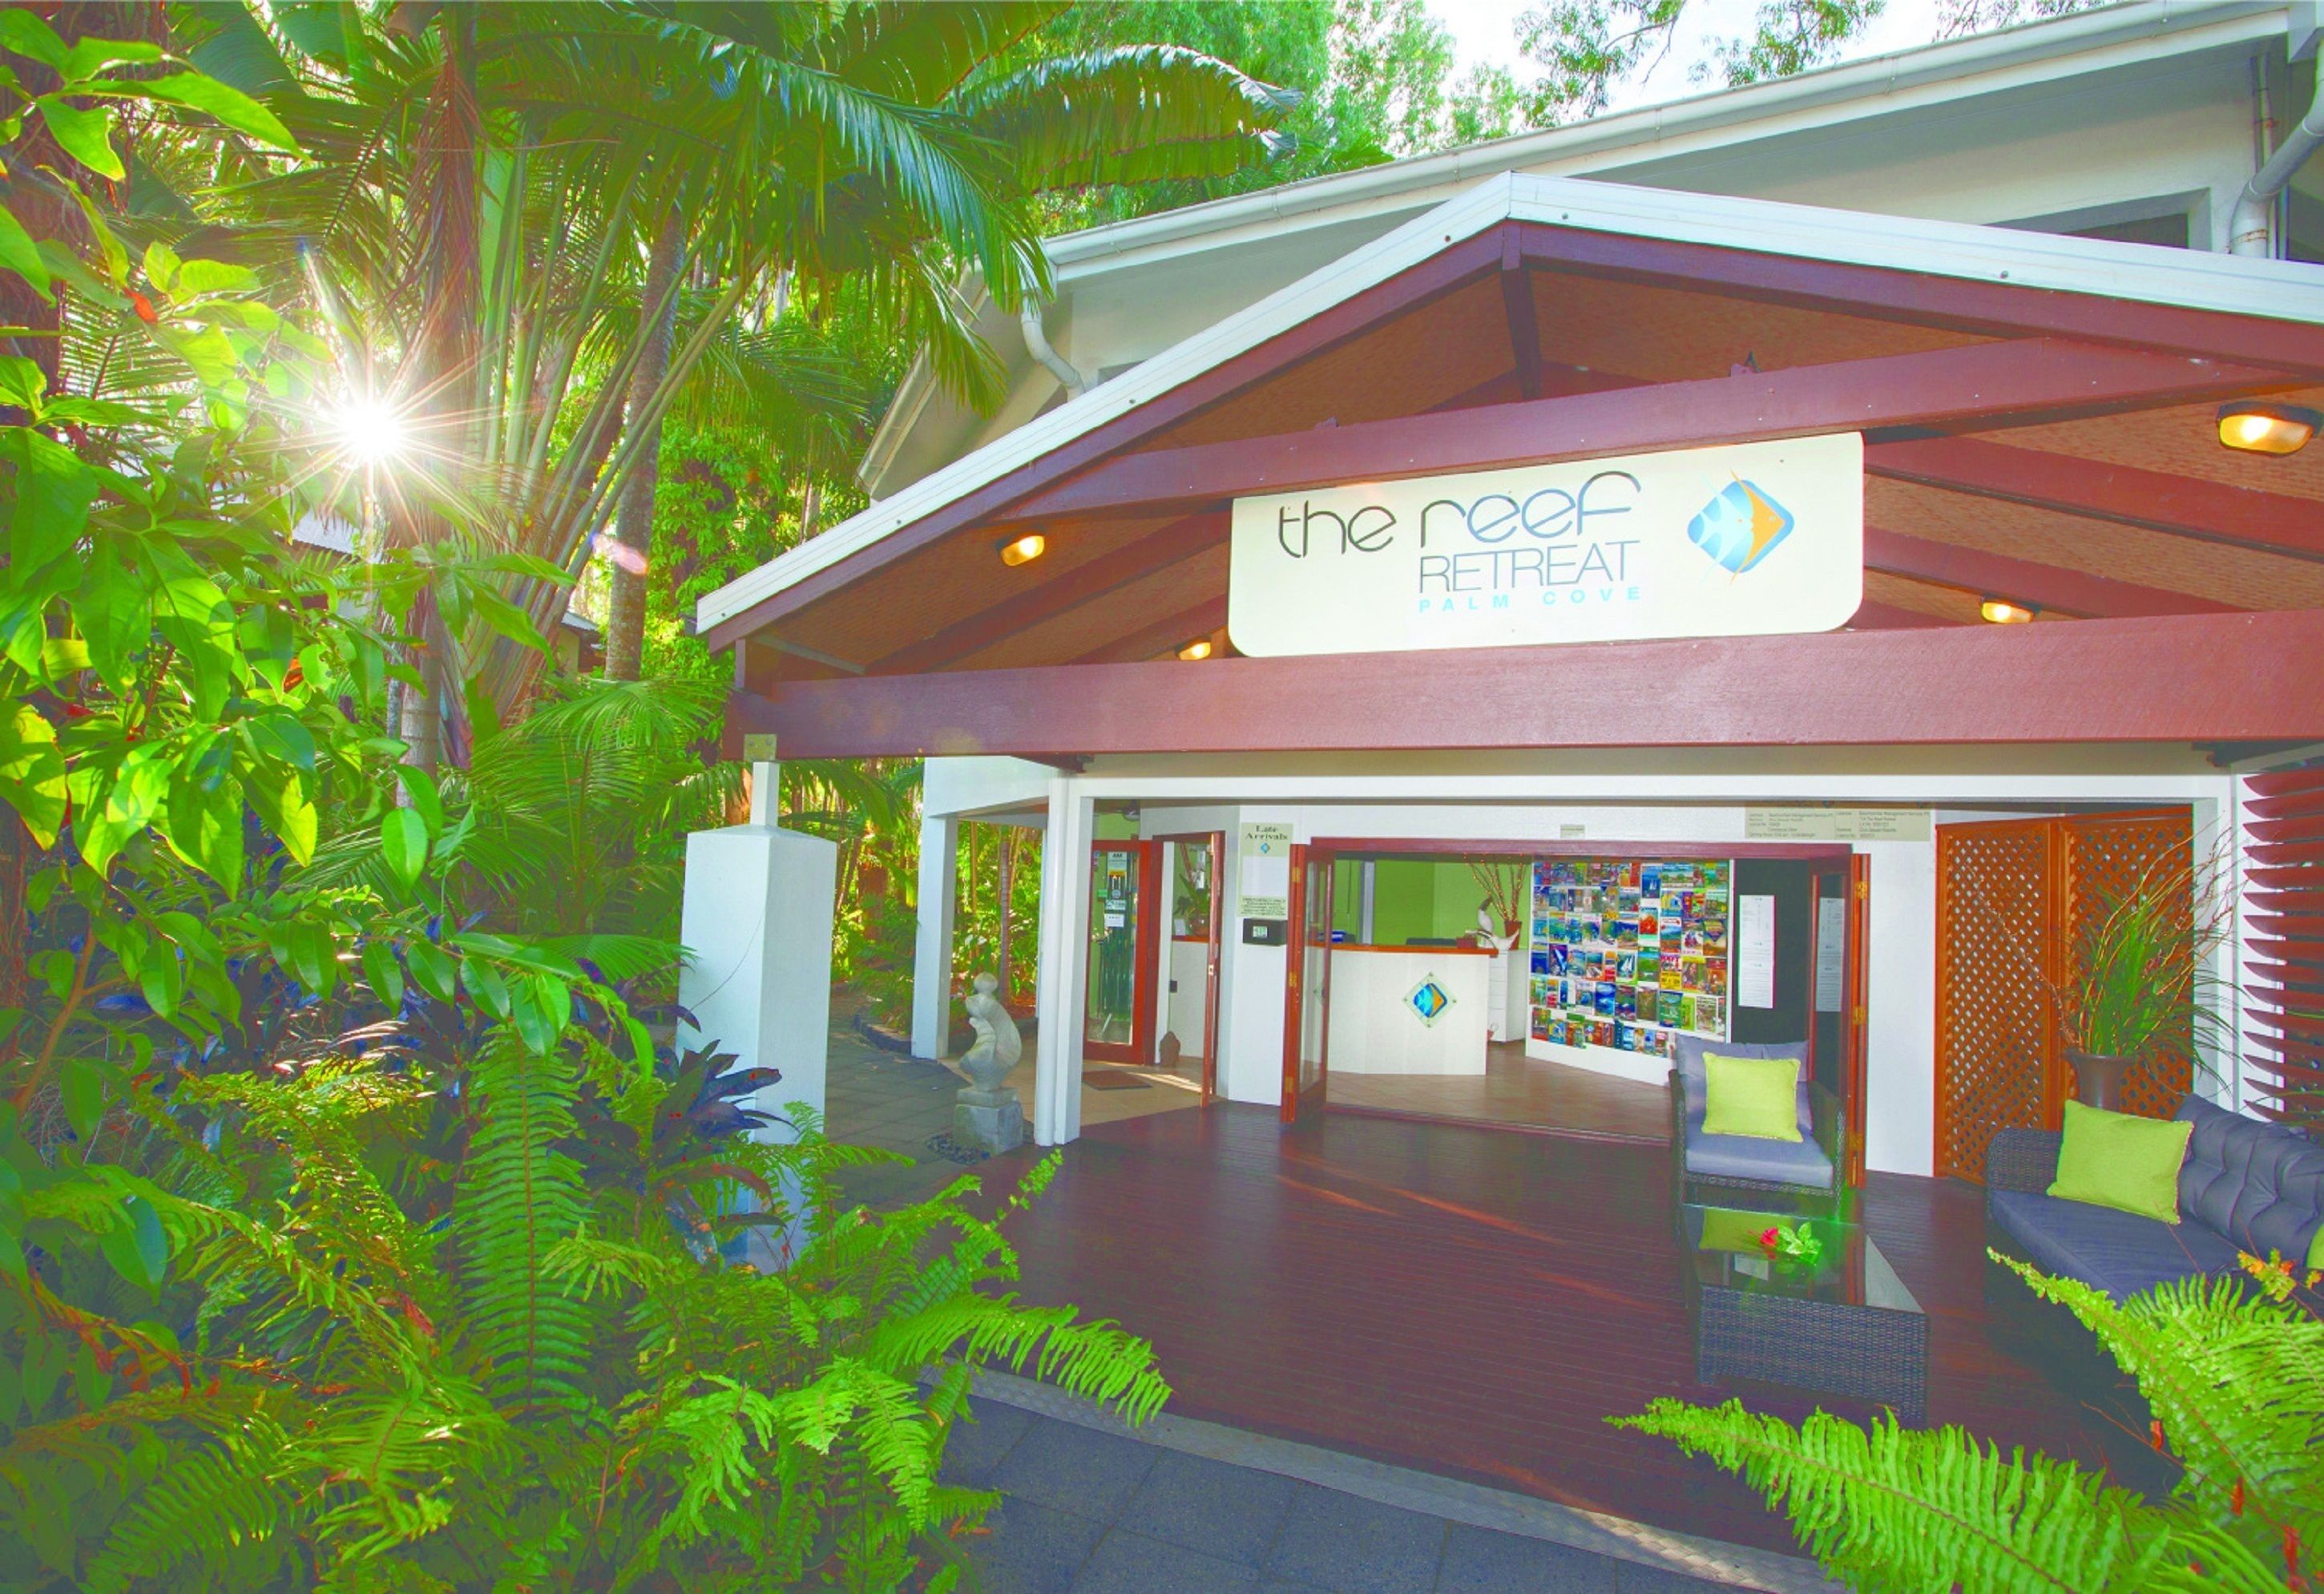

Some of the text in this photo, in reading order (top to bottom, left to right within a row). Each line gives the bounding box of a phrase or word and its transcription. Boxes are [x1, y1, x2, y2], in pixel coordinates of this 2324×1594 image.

[1277, 470, 1642, 559] the reef
[1418, 539, 1641, 594] RETREAT
[1418, 587, 1641, 614] PALM COVE
[1245, 833, 1288, 841] Arrivals
[1256, 825, 1278, 833] Late
